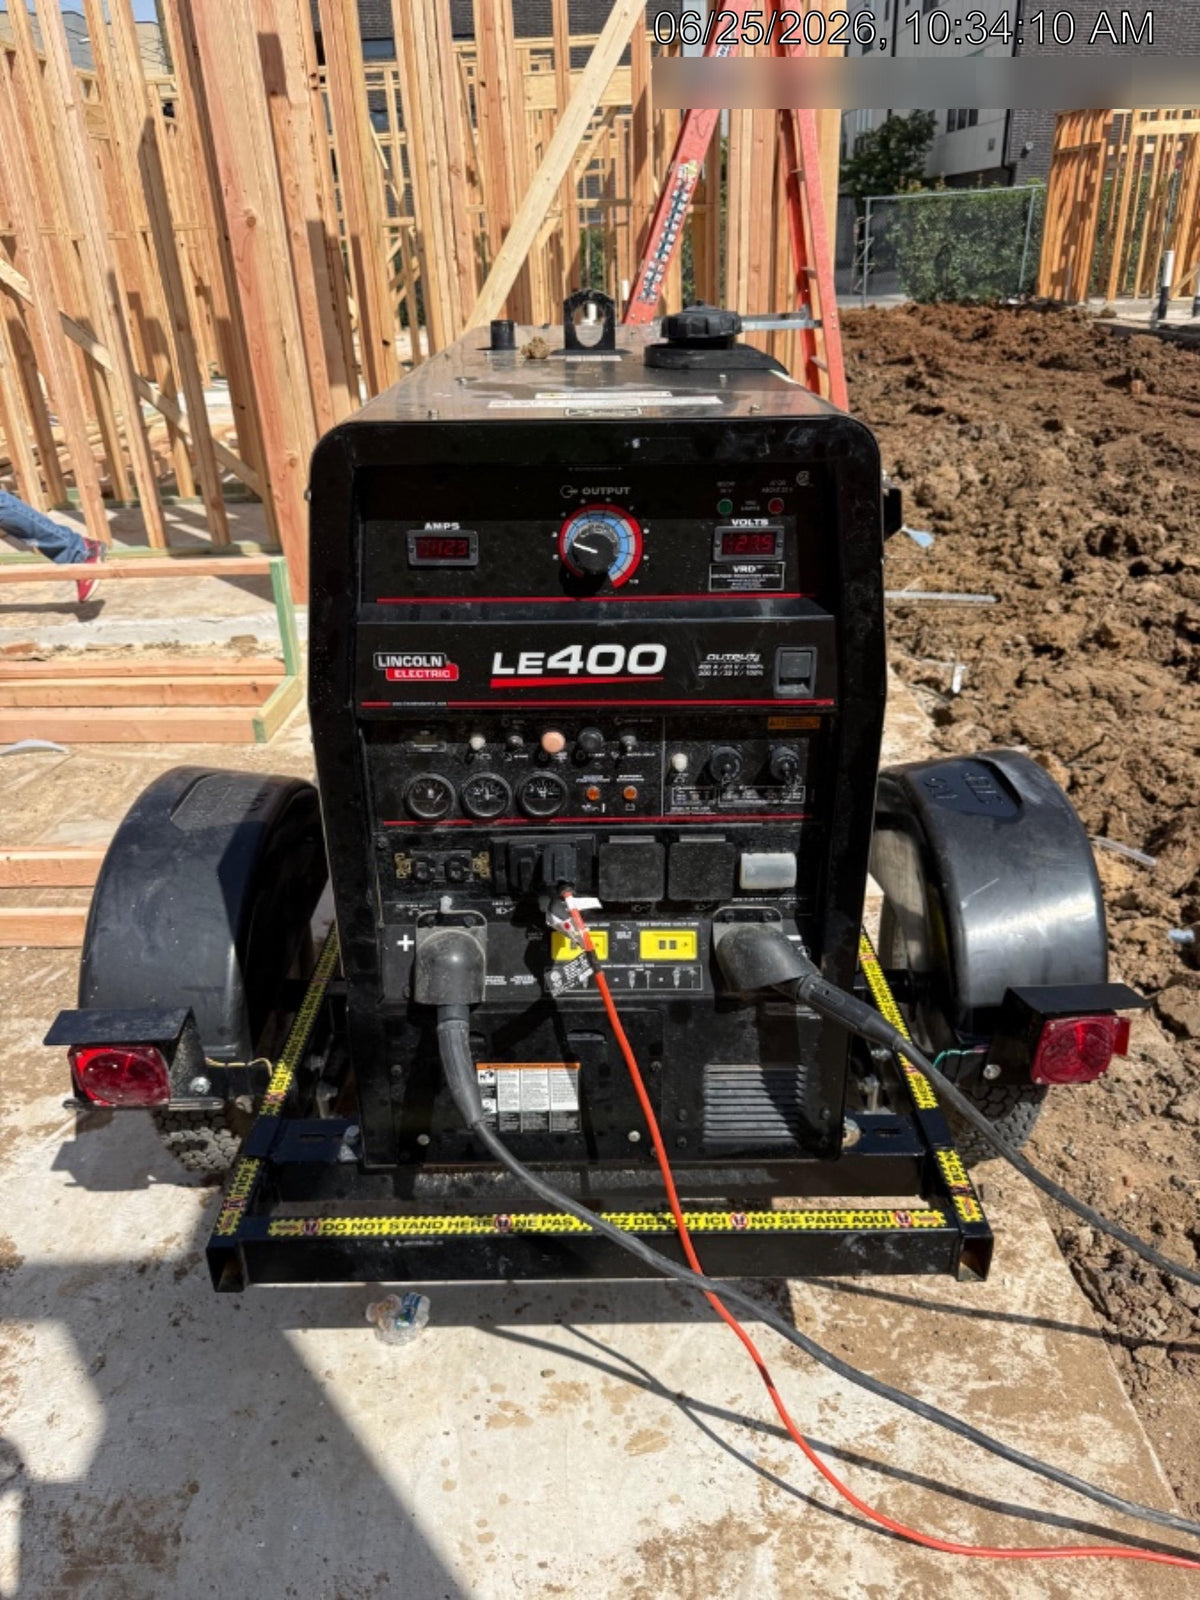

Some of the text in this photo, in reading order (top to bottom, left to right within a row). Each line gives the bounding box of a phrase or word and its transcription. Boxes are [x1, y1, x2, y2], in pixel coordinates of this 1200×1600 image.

[582, 487, 631, 495] OUTPUT
[424, 521, 460, 531] AMPS
[731, 518, 769, 526] VOLTS
[377, 655, 443, 668] LINCOLN
[491, 643, 668, 675] LE400
[394, 669, 451, 678] ELECTRIC
[514, 1218, 537, 1227] NE
[541, 1218, 574, 1227] PAS
[705, 1216, 728, 1225] ICI
[751, 1215, 890, 1225] NO SE PARE AQUI
[322, 1219, 492, 1231] DO NOT STAND HERE
